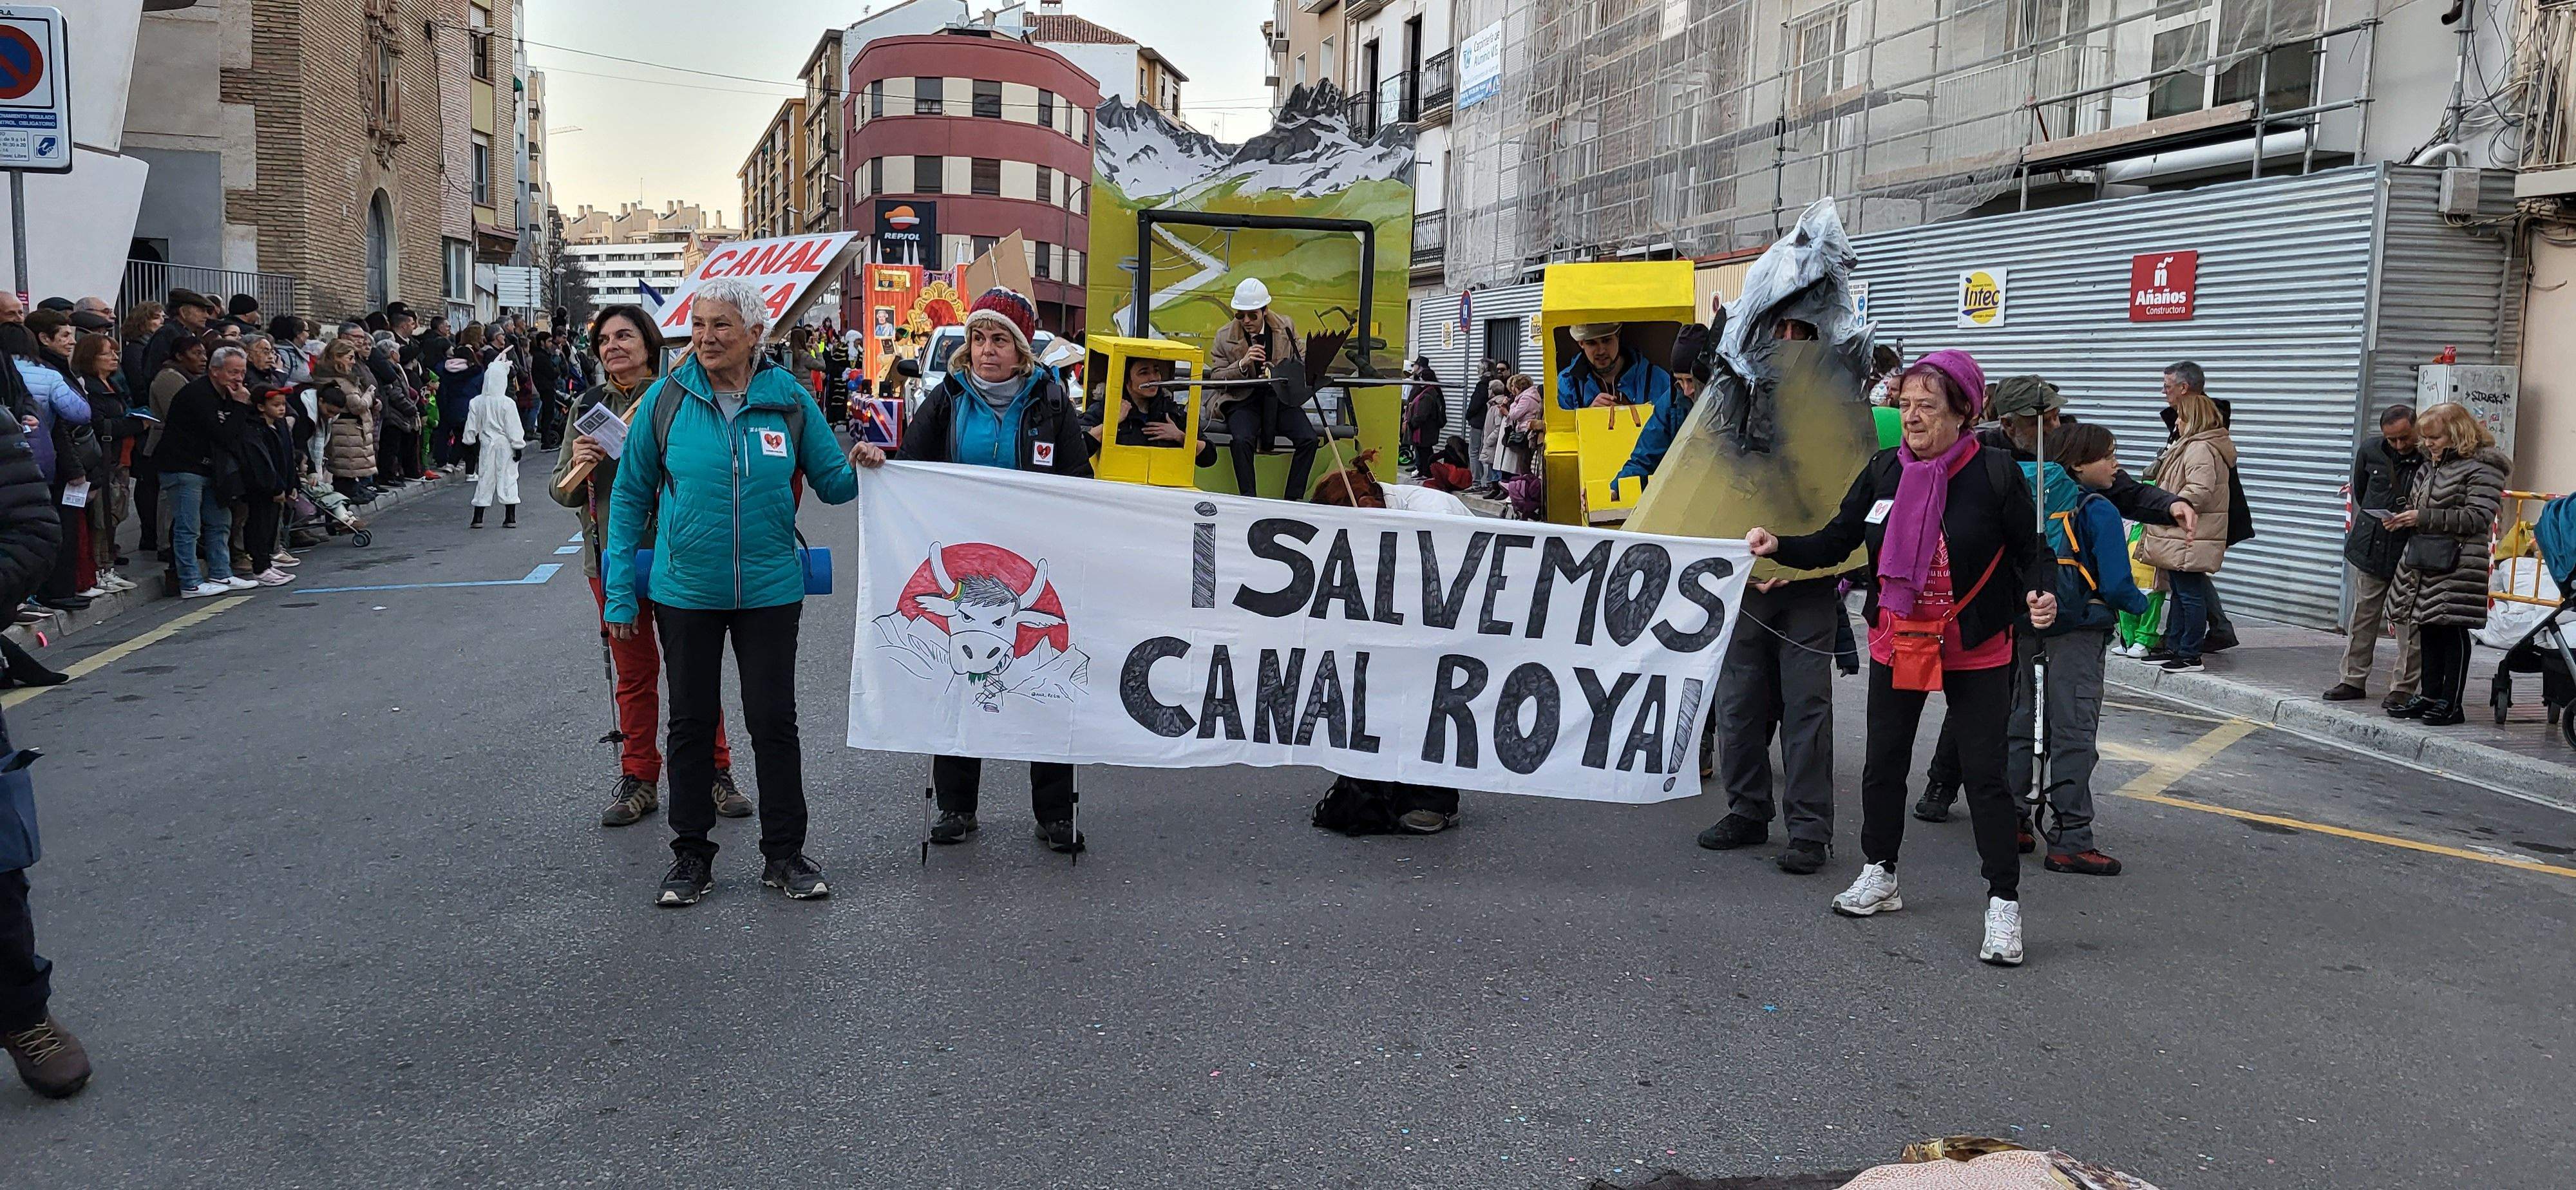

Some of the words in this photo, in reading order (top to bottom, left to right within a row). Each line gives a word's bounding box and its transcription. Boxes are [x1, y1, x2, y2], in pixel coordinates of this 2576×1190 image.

[884, 232, 920, 241] REPSOL
[699, 239, 833, 281] CANAL
[1964, 277, 2000, 307] Intec
[2135, 288, 2186, 306] Añaños
[2146, 306, 2186, 316] Constructora
[1119, 636, 1381, 754] CANAL
[1421, 654, 1703, 793] ROYA!
